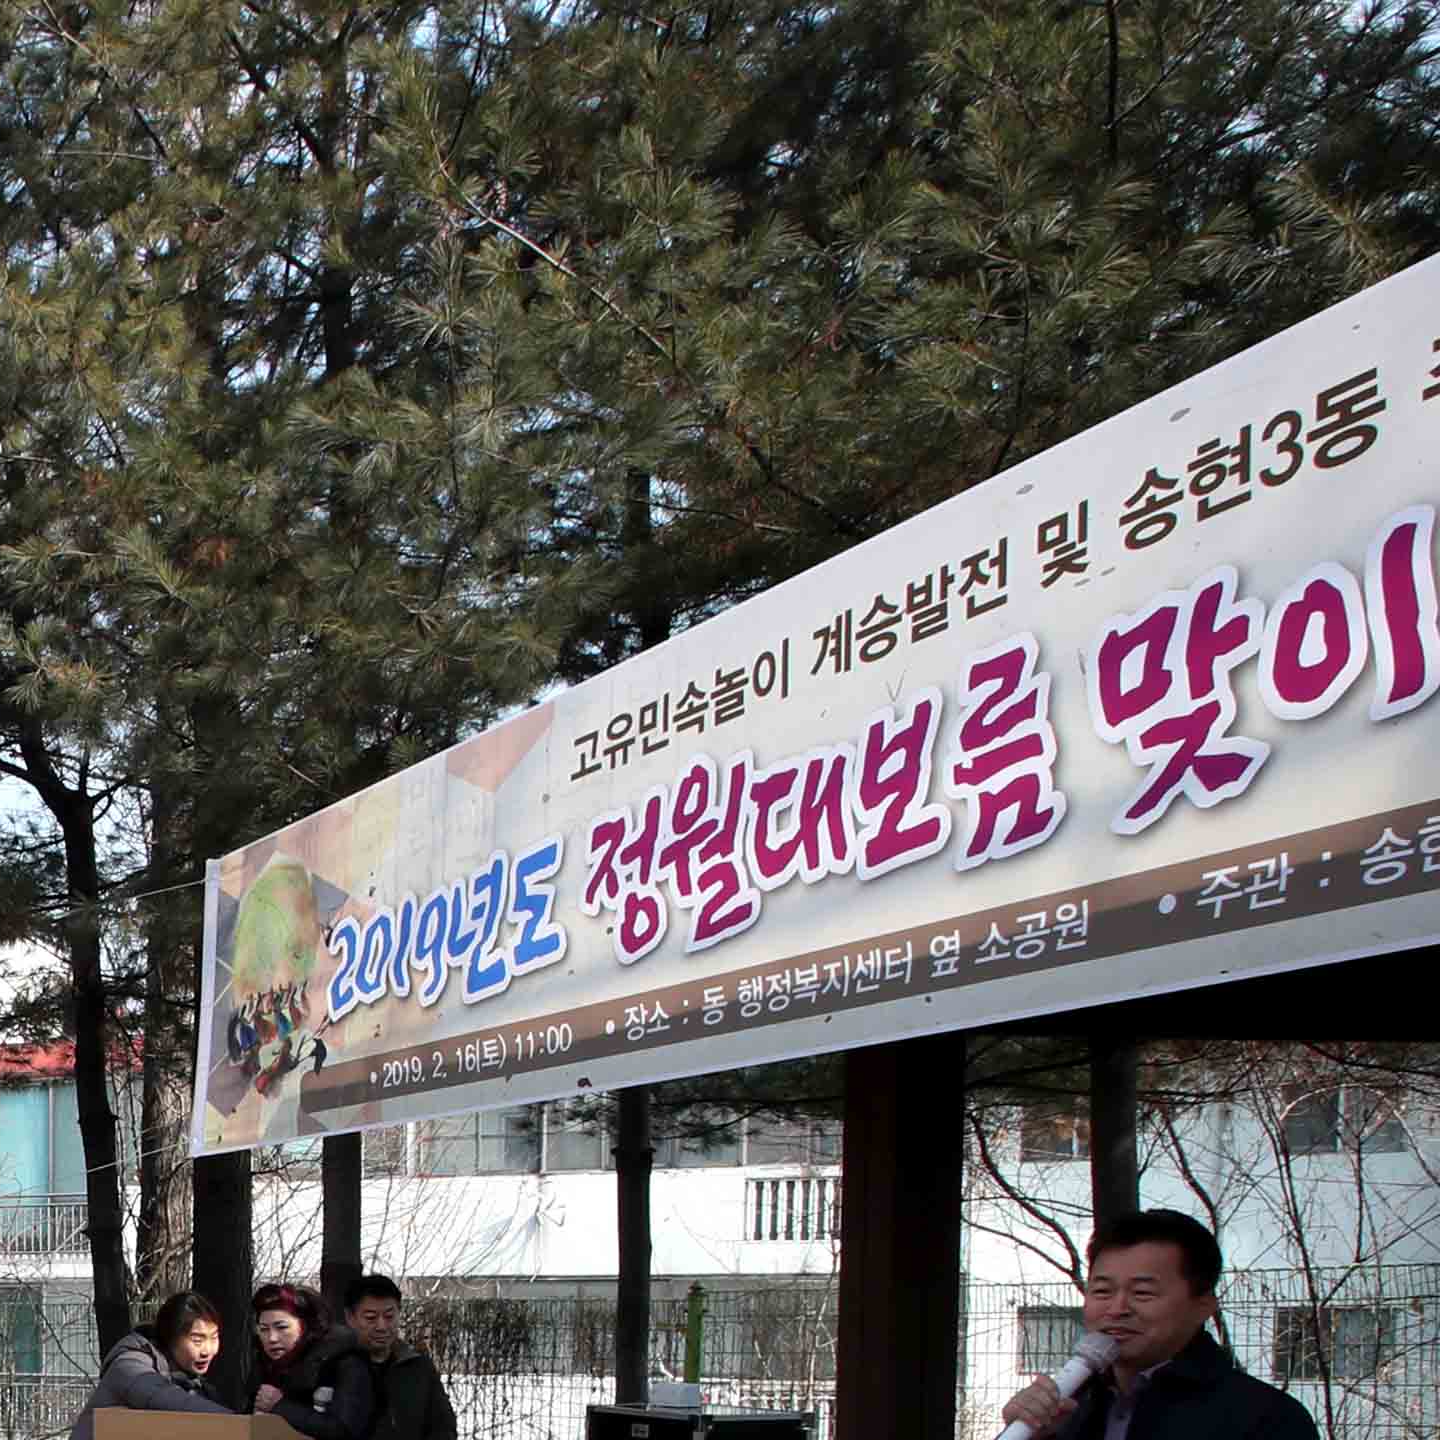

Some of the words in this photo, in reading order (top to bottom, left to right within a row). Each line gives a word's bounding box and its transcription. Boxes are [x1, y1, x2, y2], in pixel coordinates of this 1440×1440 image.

[329, 839, 563, 1013] 2019년도
[583, 644, 1057, 956] 정월대보름
[1096, 520, 1427, 822] 맞이
[569, 637, 791, 783] 고유민속놀이
[809, 536, 1009, 677] 계승발전
[1036, 498, 1090, 589] 및
[1119, 366, 1387, 552] 송현3동
[456, 1033, 507, 1073] 16(토)
[515, 1023, 573, 1059] 11:00
[624, 999, 671, 1041] 장소
[701, 986, 726, 1026] 동
[737, 939, 913, 1019] 행정복지센터
[929, 928, 961, 979] 옆
[974, 897, 1090, 965] 소공원
[1196, 851, 1295, 919] 주관
